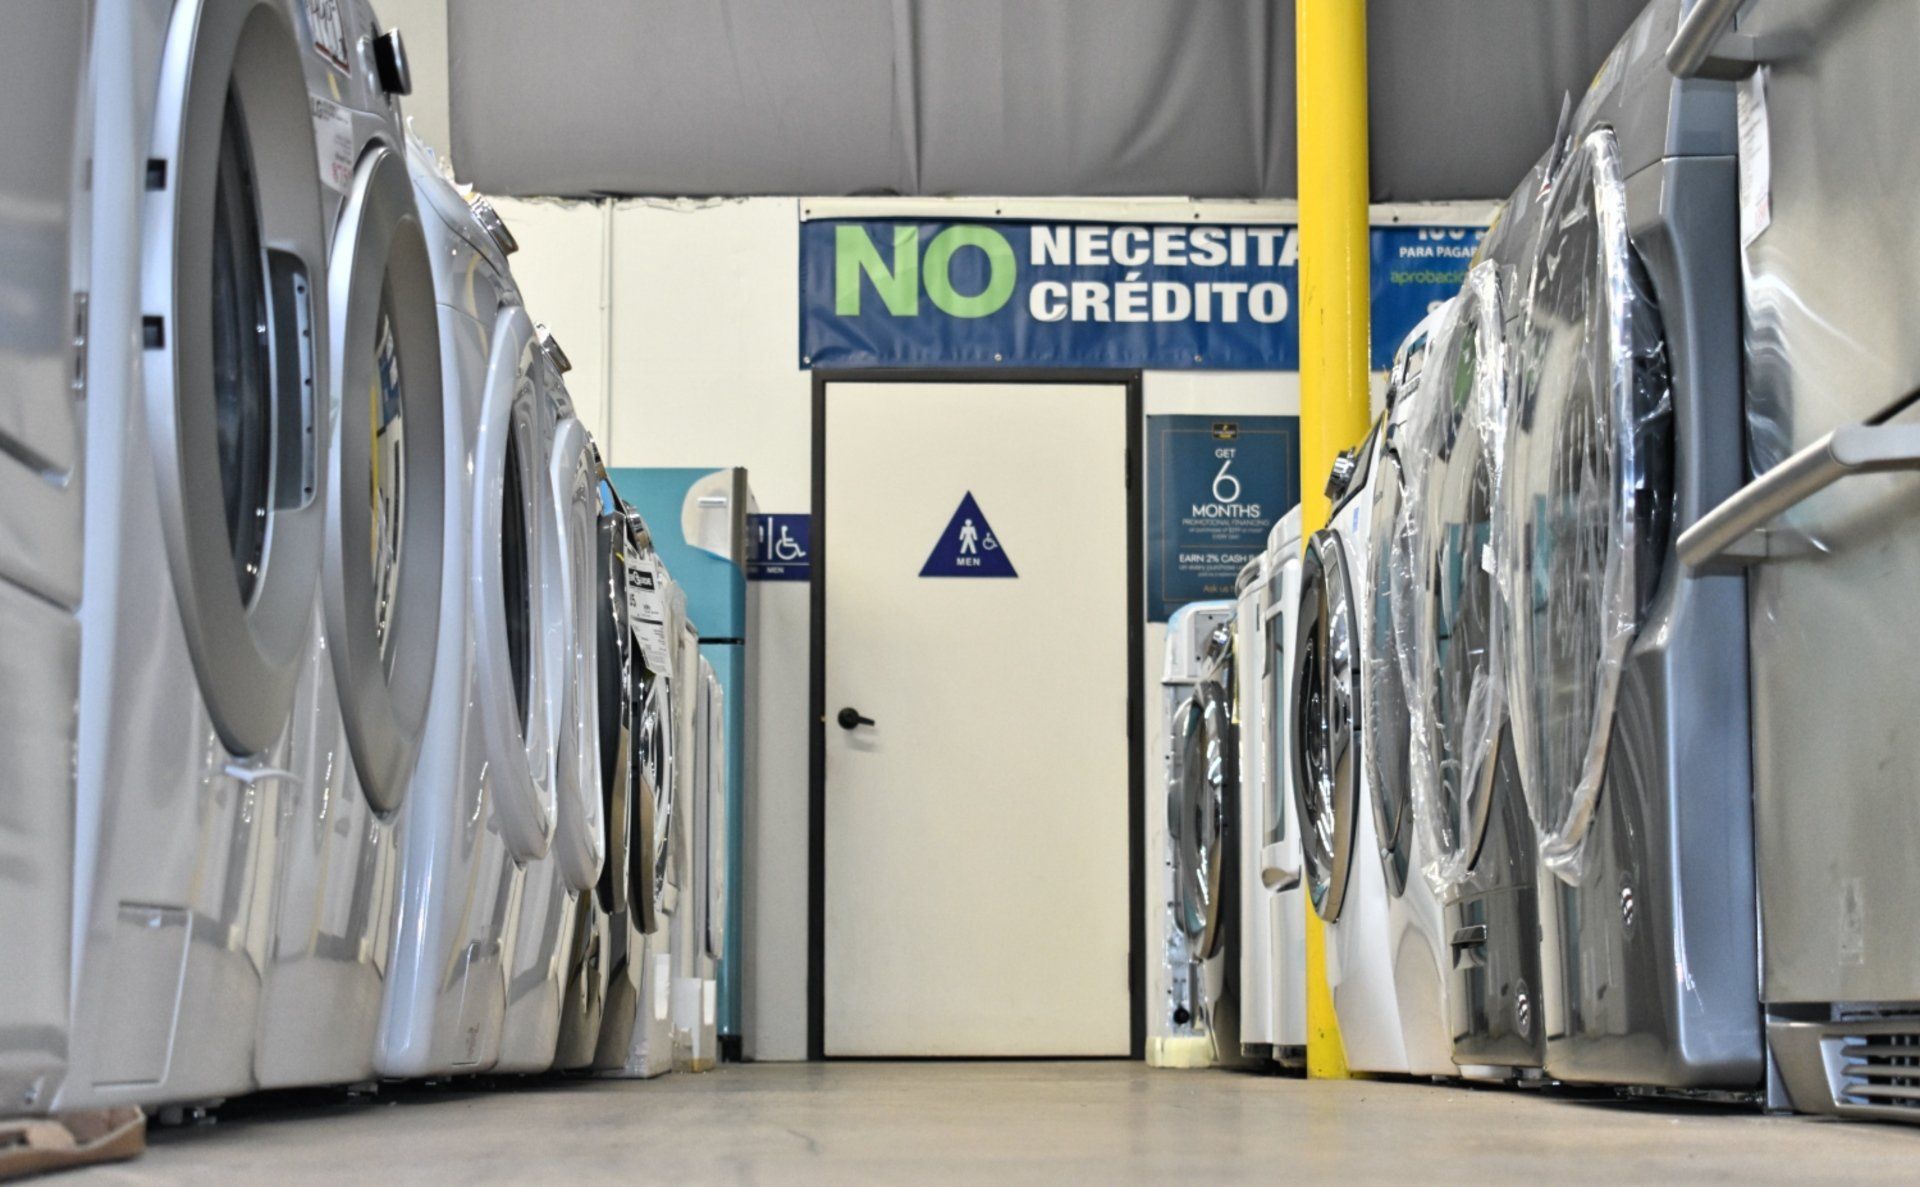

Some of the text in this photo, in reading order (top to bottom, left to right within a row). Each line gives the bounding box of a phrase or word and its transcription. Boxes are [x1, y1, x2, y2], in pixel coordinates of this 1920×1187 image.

[1399, 246, 1433, 258] PARA
[834, 224, 1017, 318] NO
[1029, 271, 1288, 323] CRÉDITO
[1215, 448, 1236, 459] GET
[1212, 459, 1241, 503] 6
[1192, 504, 1261, 518] MONTHS
[956, 557, 981, 567] MEN
[1179, 554, 1205, 563] EARN
[1220, 554, 1247, 563] CASH
[766, 566, 784, 574] MEN
